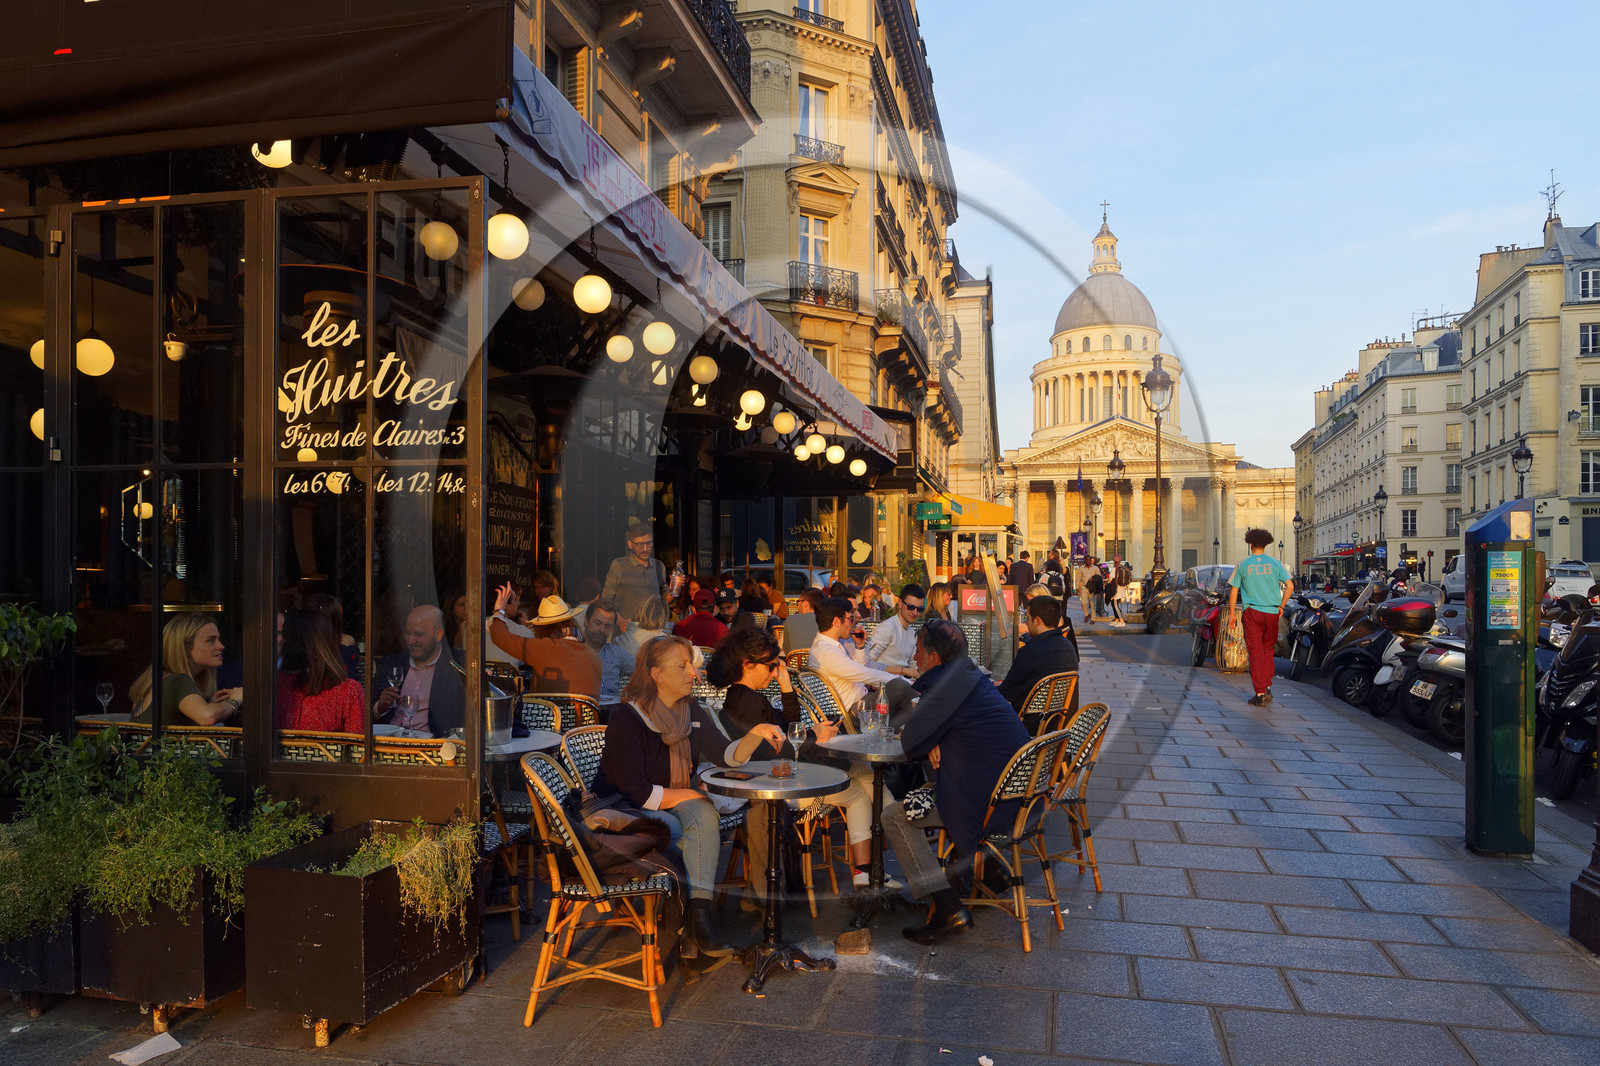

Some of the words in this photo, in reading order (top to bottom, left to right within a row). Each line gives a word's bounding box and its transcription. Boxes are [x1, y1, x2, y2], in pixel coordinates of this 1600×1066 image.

[302, 301, 360, 347] les
[283, 352, 458, 422] Huitres
[281, 422, 340, 449] Fines
[342, 423, 366, 447] de
[373, 420, 444, 447] Claires
[283, 473, 308, 494] les
[376, 473, 403, 493] les
[1582, 507, 1600, 515] BN
[486, 524, 511, 547] UNCH
[513, 528, 534, 552] Plat
[486, 564, 510, 575] INNER
[1248, 564, 1272, 576] FCB
